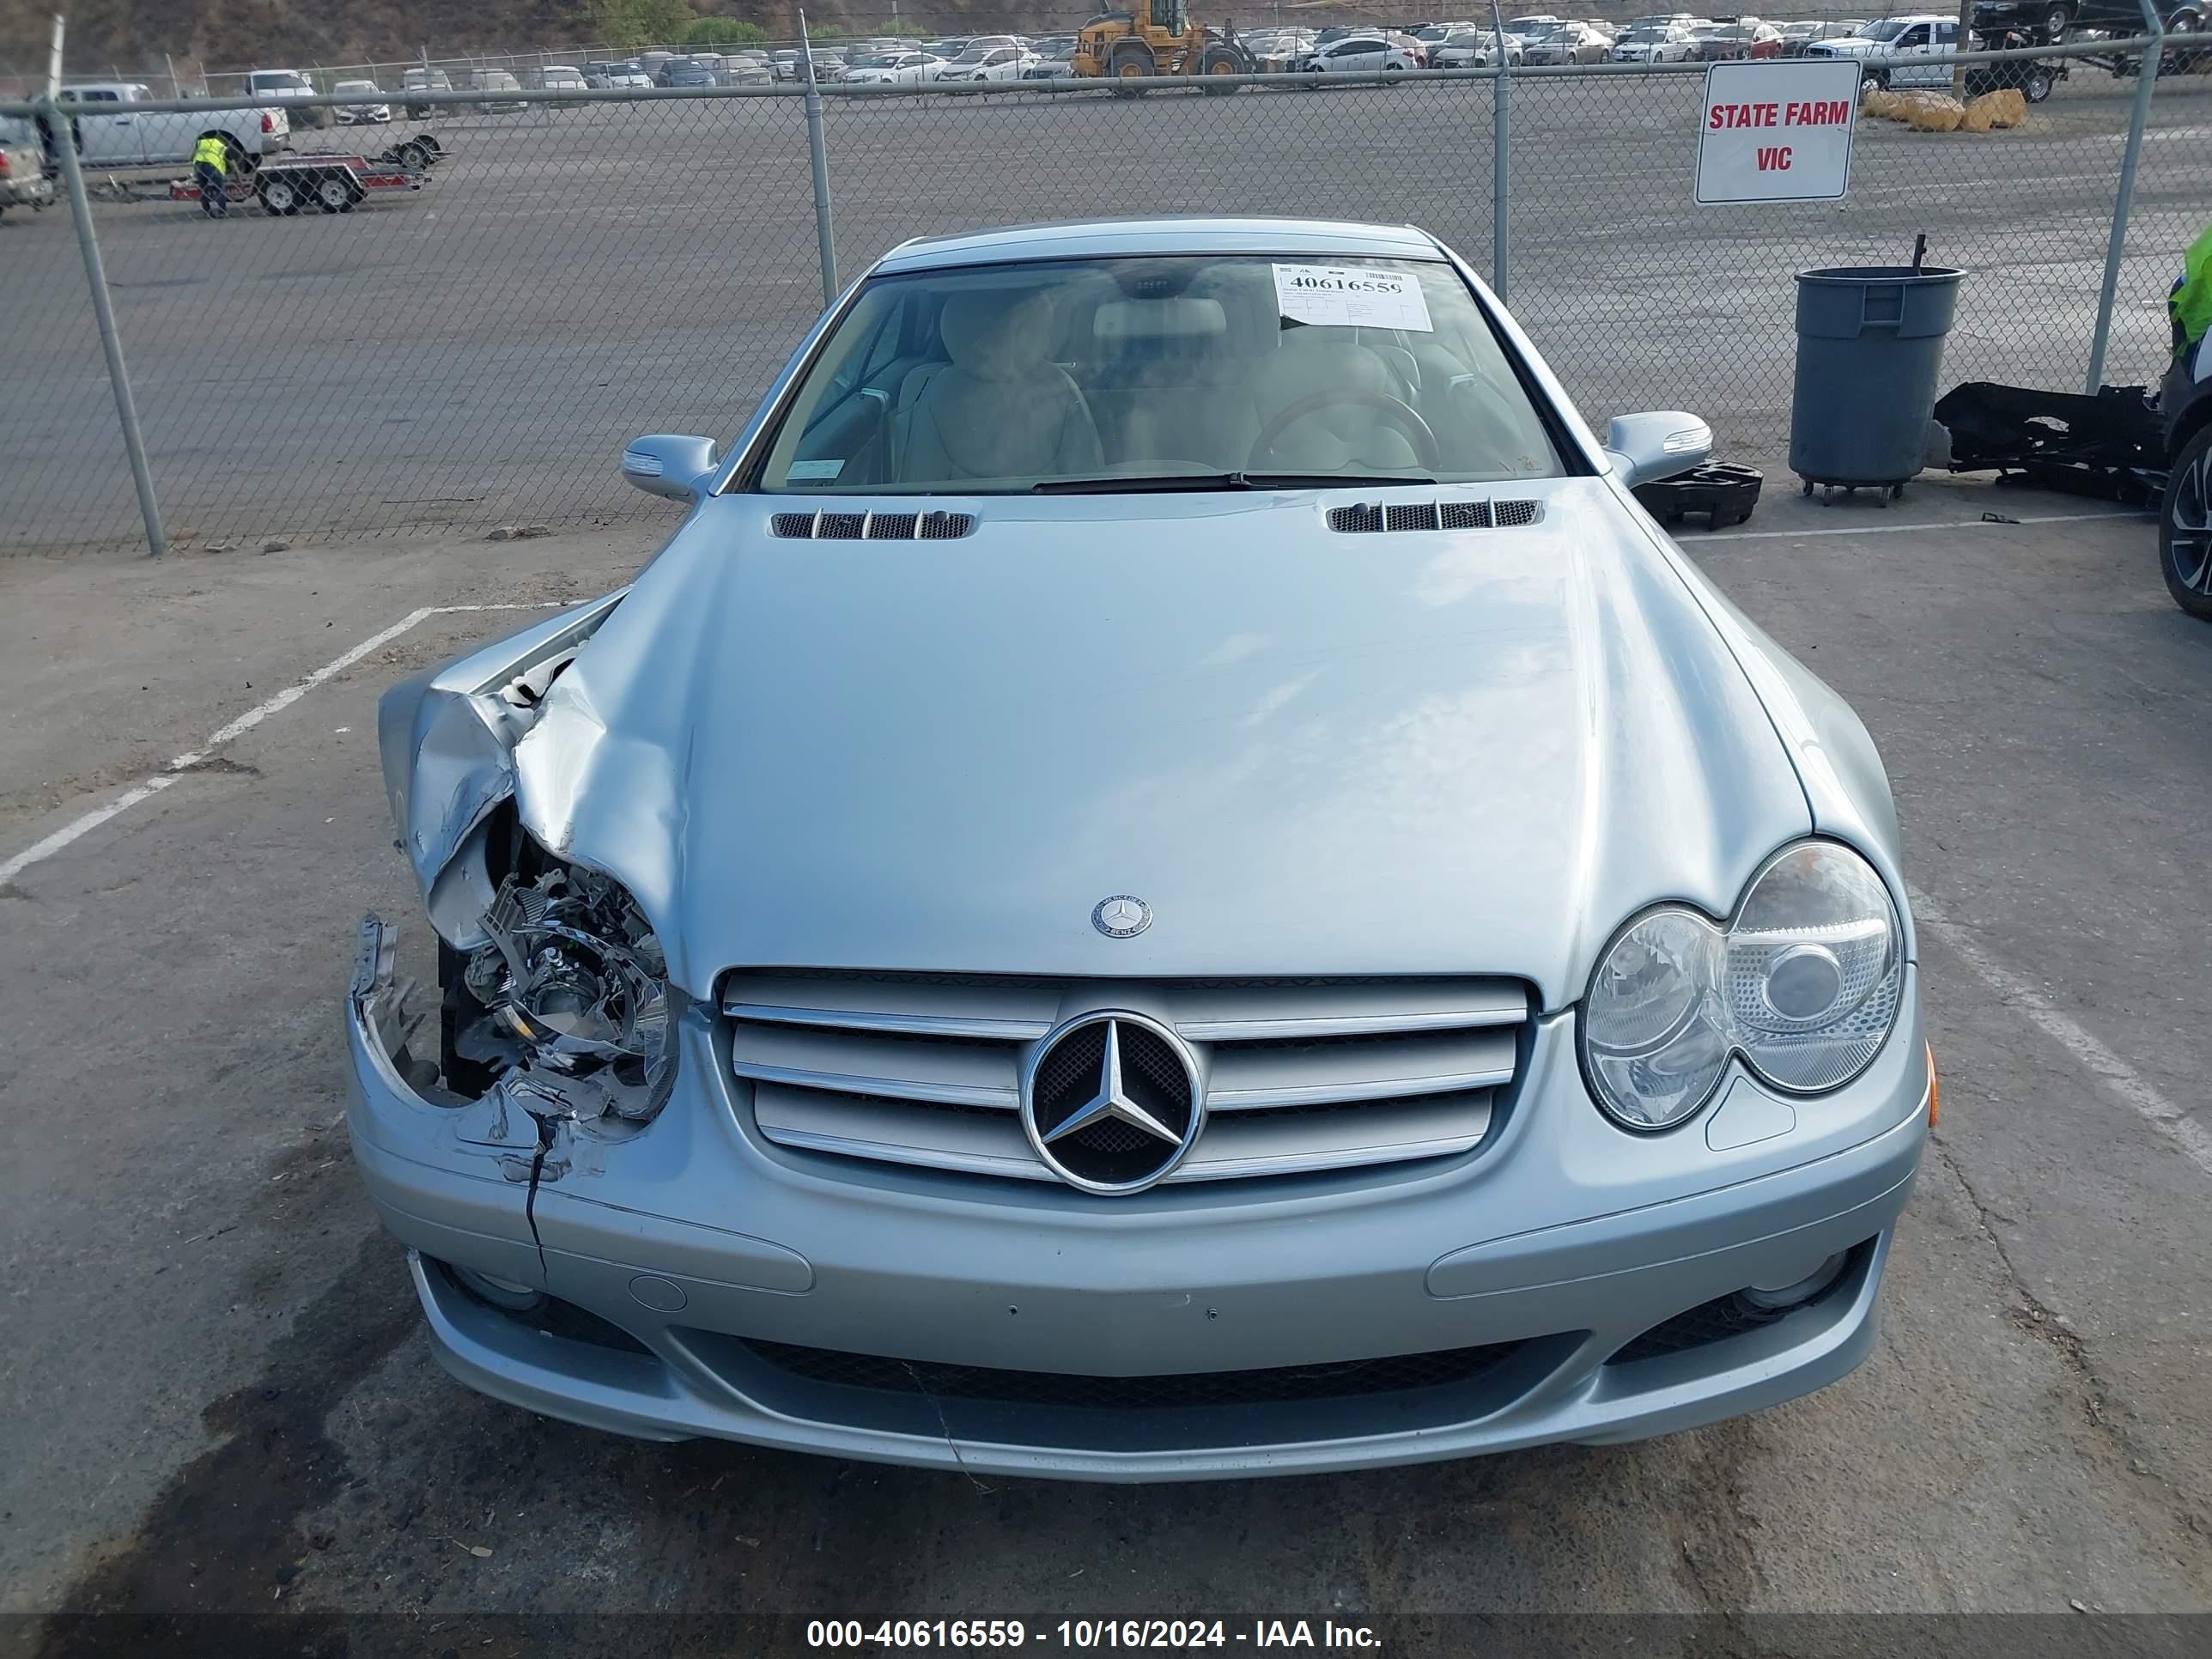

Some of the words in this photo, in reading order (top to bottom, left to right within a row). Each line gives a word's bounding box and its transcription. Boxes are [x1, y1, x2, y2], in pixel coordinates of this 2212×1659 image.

[1709, 103, 1778, 129] STATE
[1784, 101, 1849, 126] FARM
[1757, 147, 1792, 171] VIC
[1290, 276, 1402, 295] 40616559
